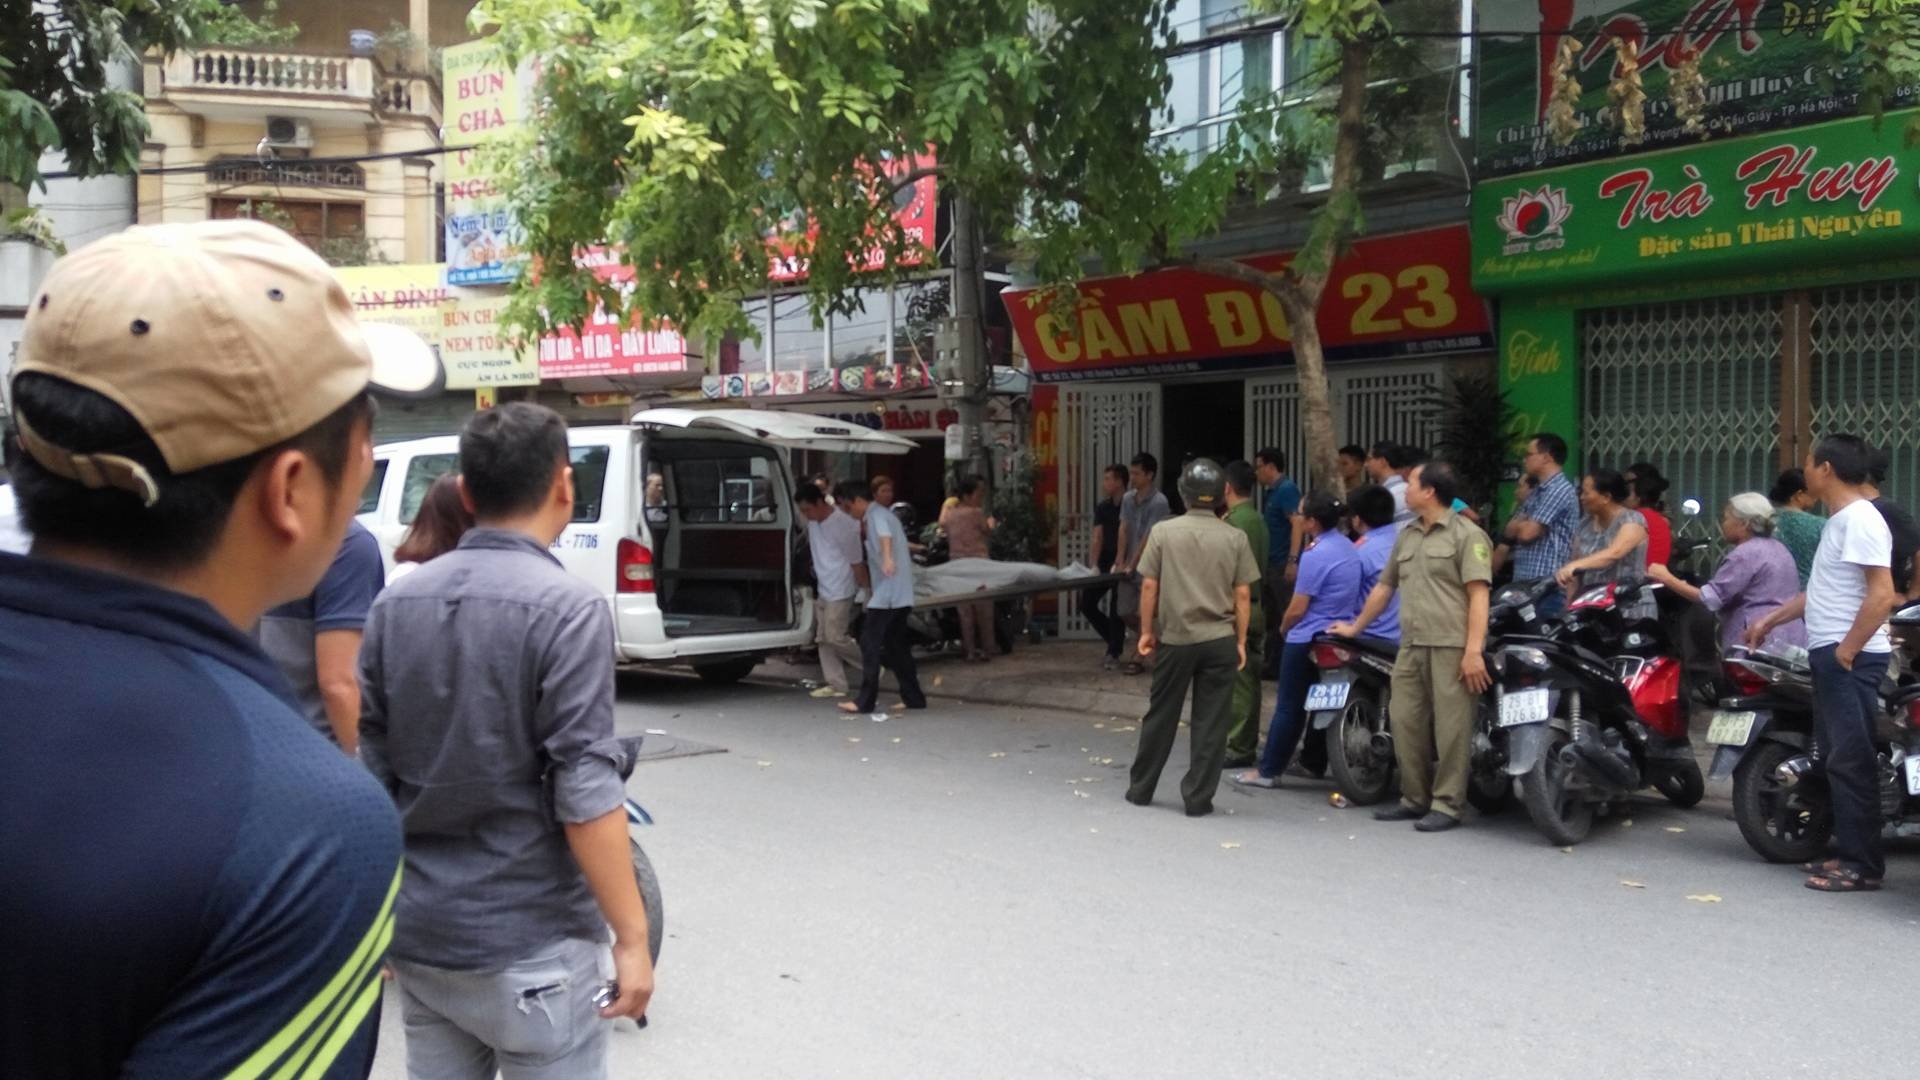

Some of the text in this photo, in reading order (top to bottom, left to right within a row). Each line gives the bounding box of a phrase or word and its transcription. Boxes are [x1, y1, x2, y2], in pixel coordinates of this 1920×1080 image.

[1600, 144, 1898, 229] Trà Huy
[1639, 208, 1903, 259] Đặc sản Thái Nguyên
[1343, 264, 1458, 335] 23
